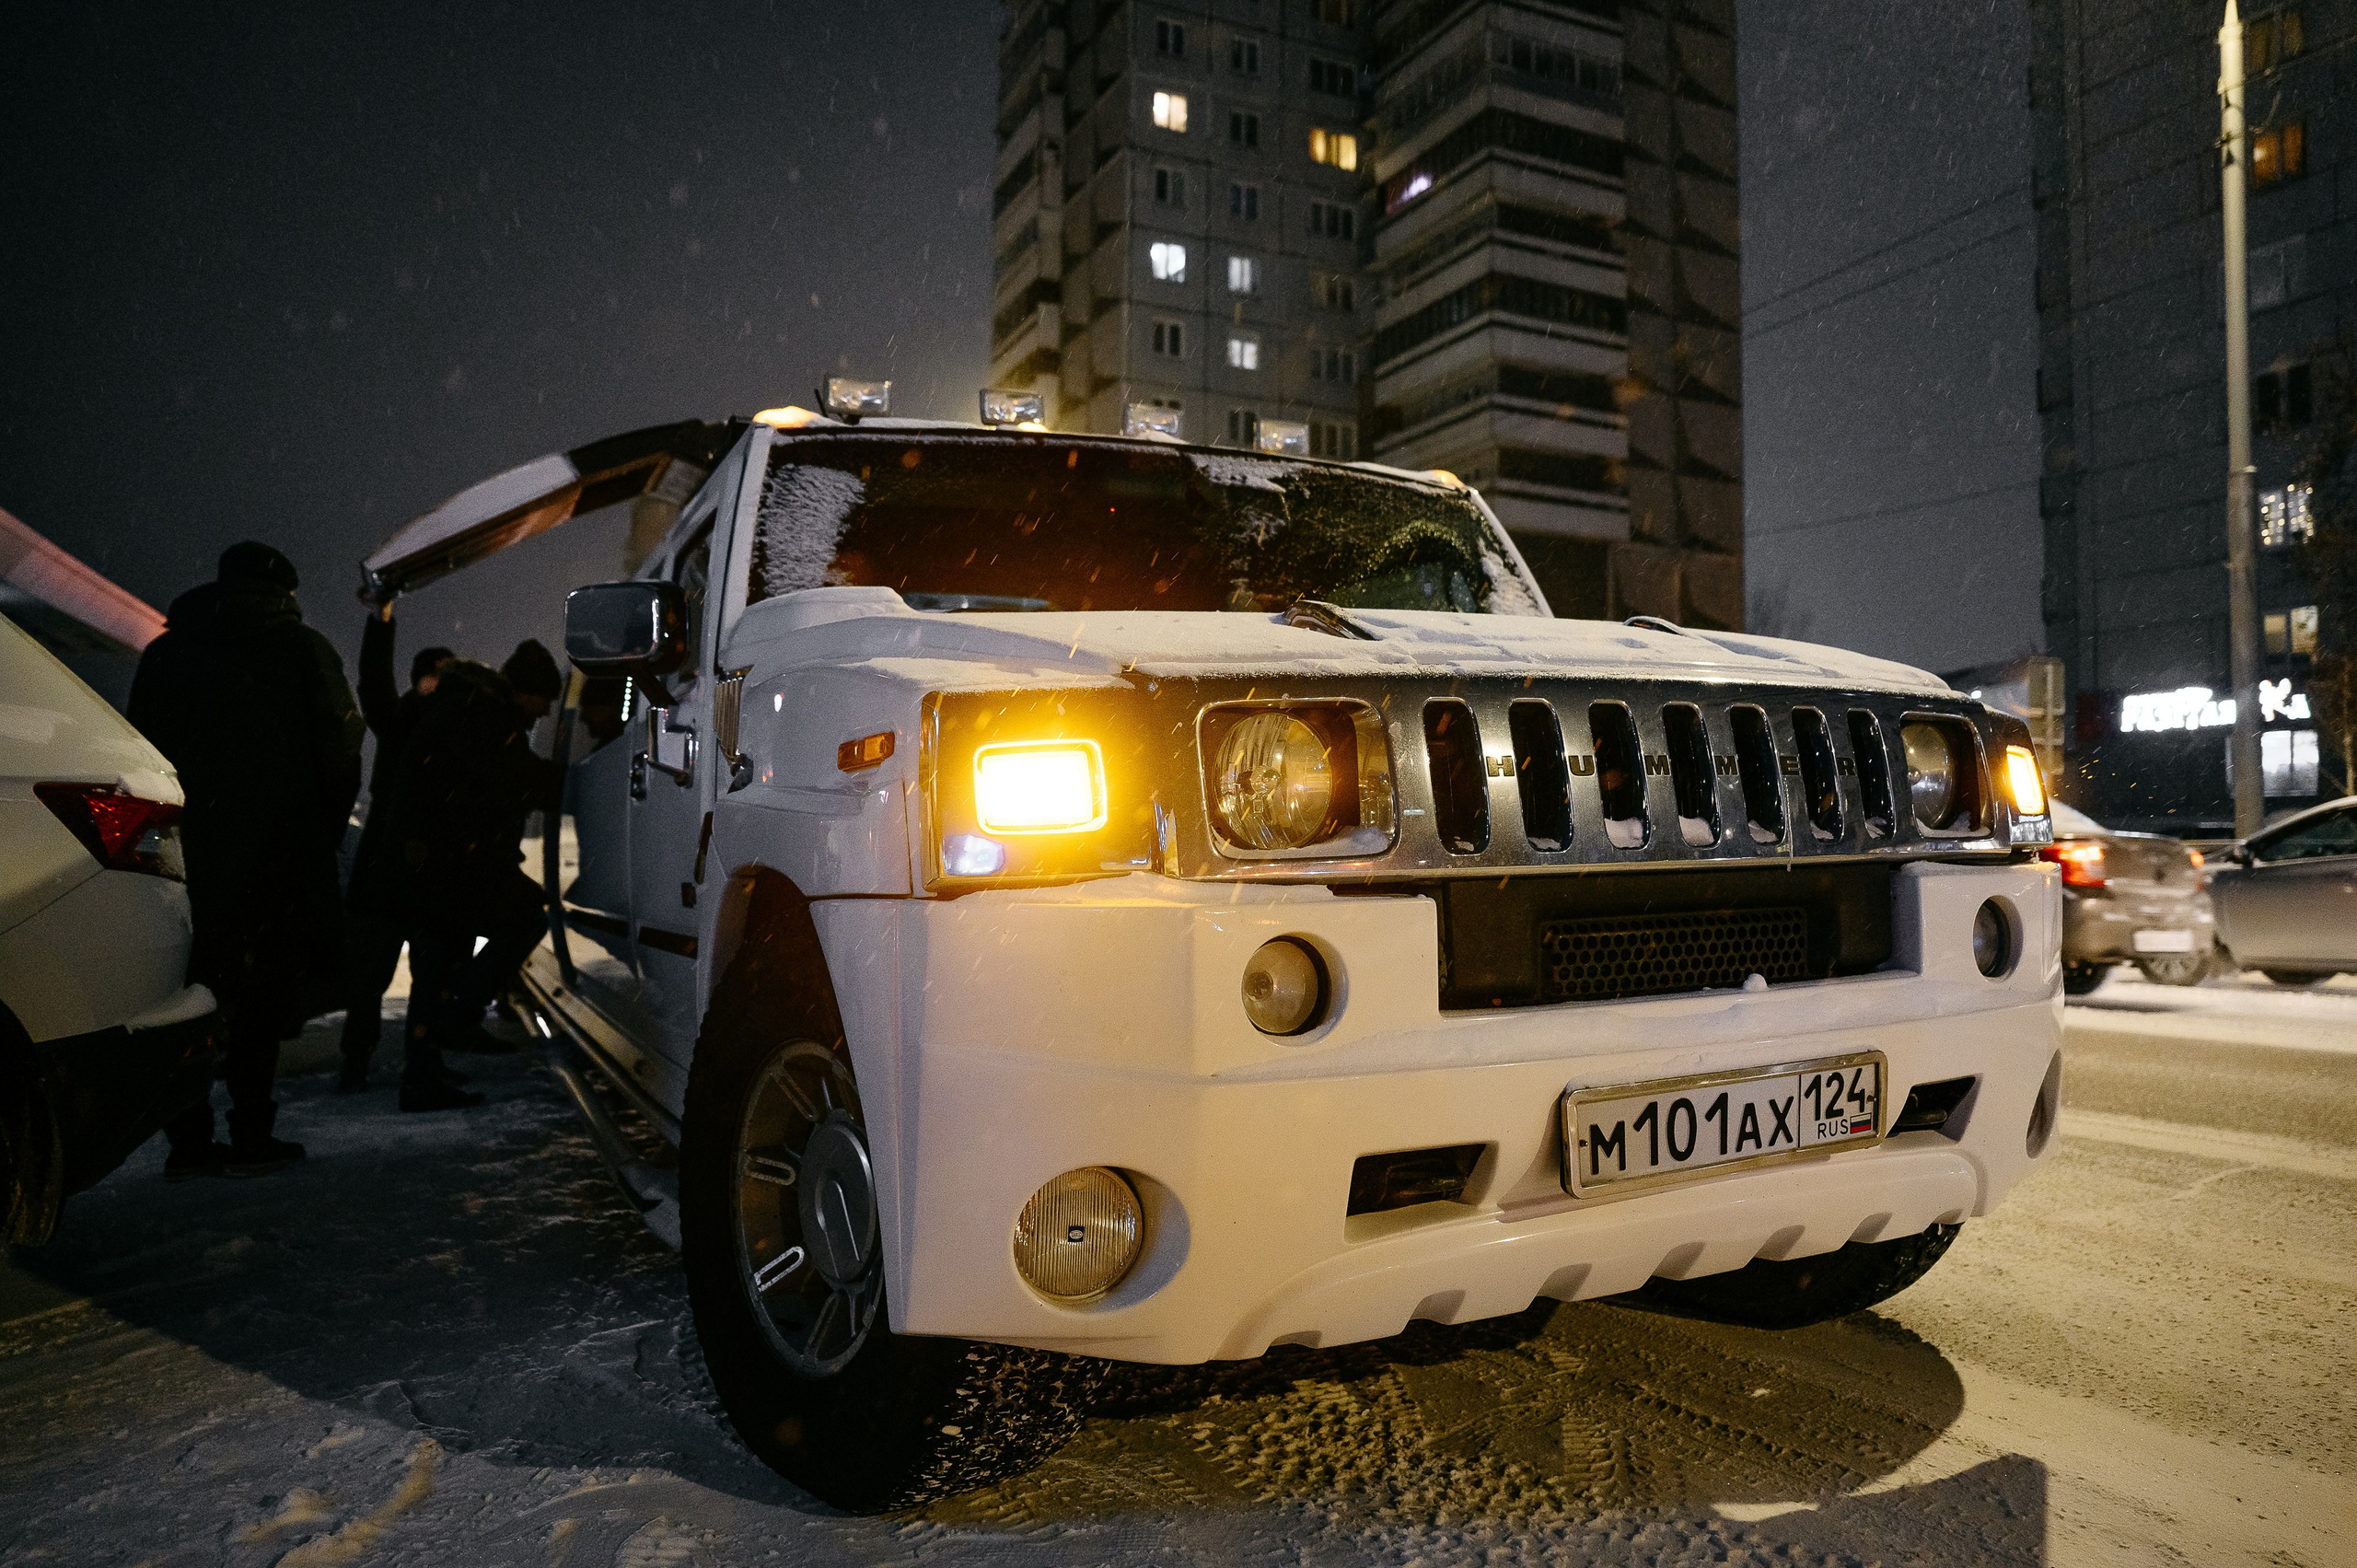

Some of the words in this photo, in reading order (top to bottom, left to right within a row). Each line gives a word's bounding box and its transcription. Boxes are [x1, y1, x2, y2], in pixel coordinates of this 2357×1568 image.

[1485, 754, 1856, 777] HUMMER
[1804, 1067, 1867, 1122] 124
[1817, 1119, 1850, 1140] RUS
